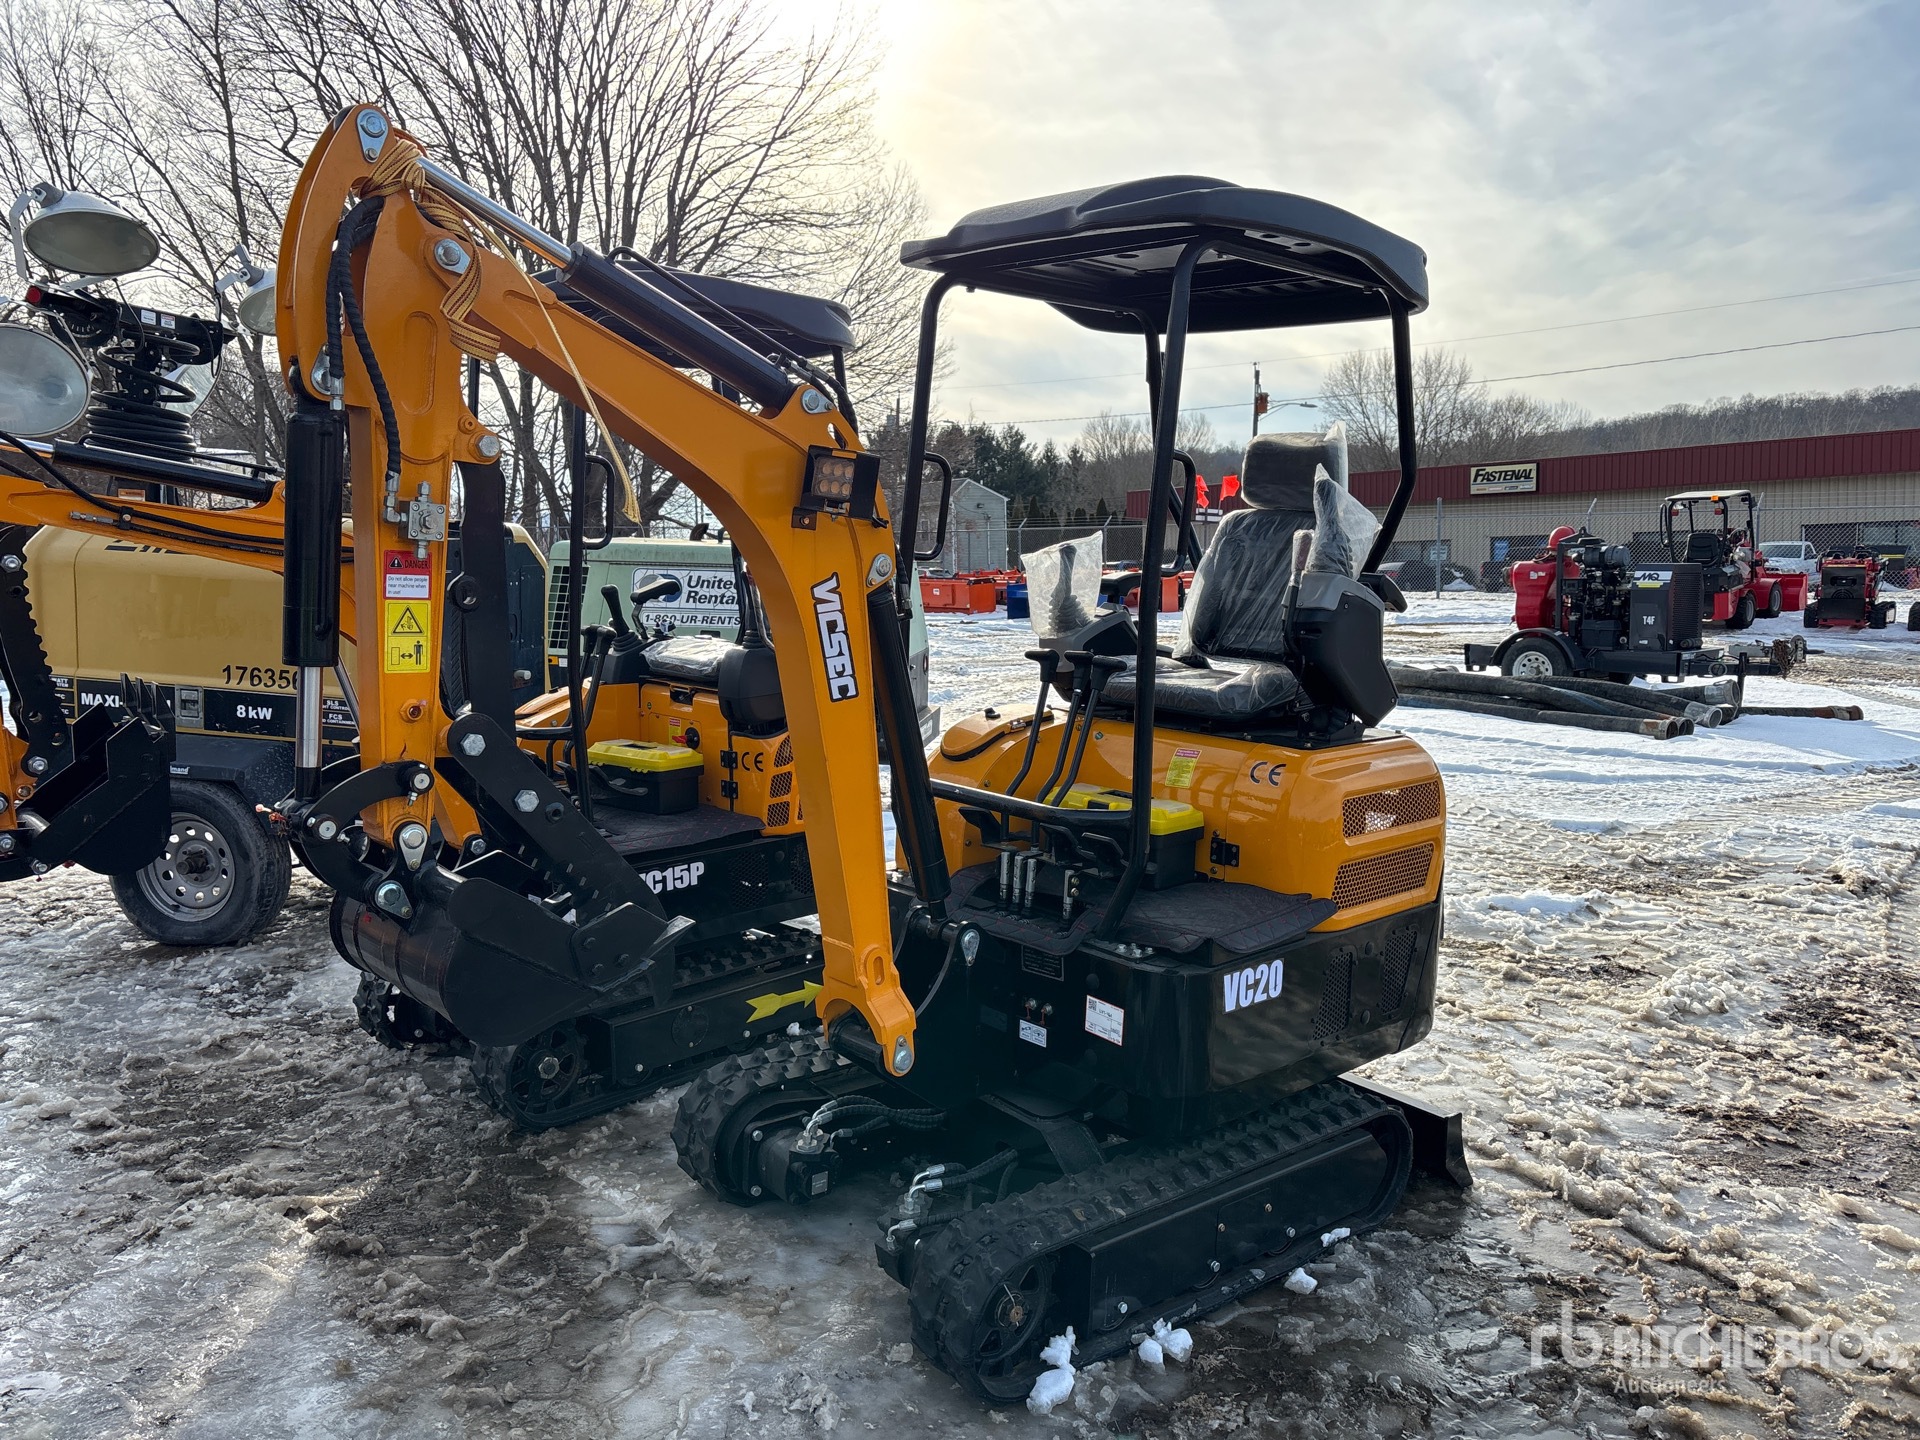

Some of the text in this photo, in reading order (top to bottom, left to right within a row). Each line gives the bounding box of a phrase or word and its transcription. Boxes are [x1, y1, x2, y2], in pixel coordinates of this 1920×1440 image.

[1473, 468, 1534, 483] FASTENAL
[405, 560, 428, 569] DANGER
[687, 575, 736, 590] Unite
[1639, 573, 1660, 581] MQ
[1643, 616, 1655, 625] T4F
[811, 572, 859, 702] VICSEC
[81, 692, 124, 708] MAXI-
[236, 704, 273, 720] 8 kW
[741, 752, 764, 772] CE
[1250, 761, 1287, 787] CE
[639, 862, 705, 894] C15P
[1223, 960, 1283, 1012] VC20
